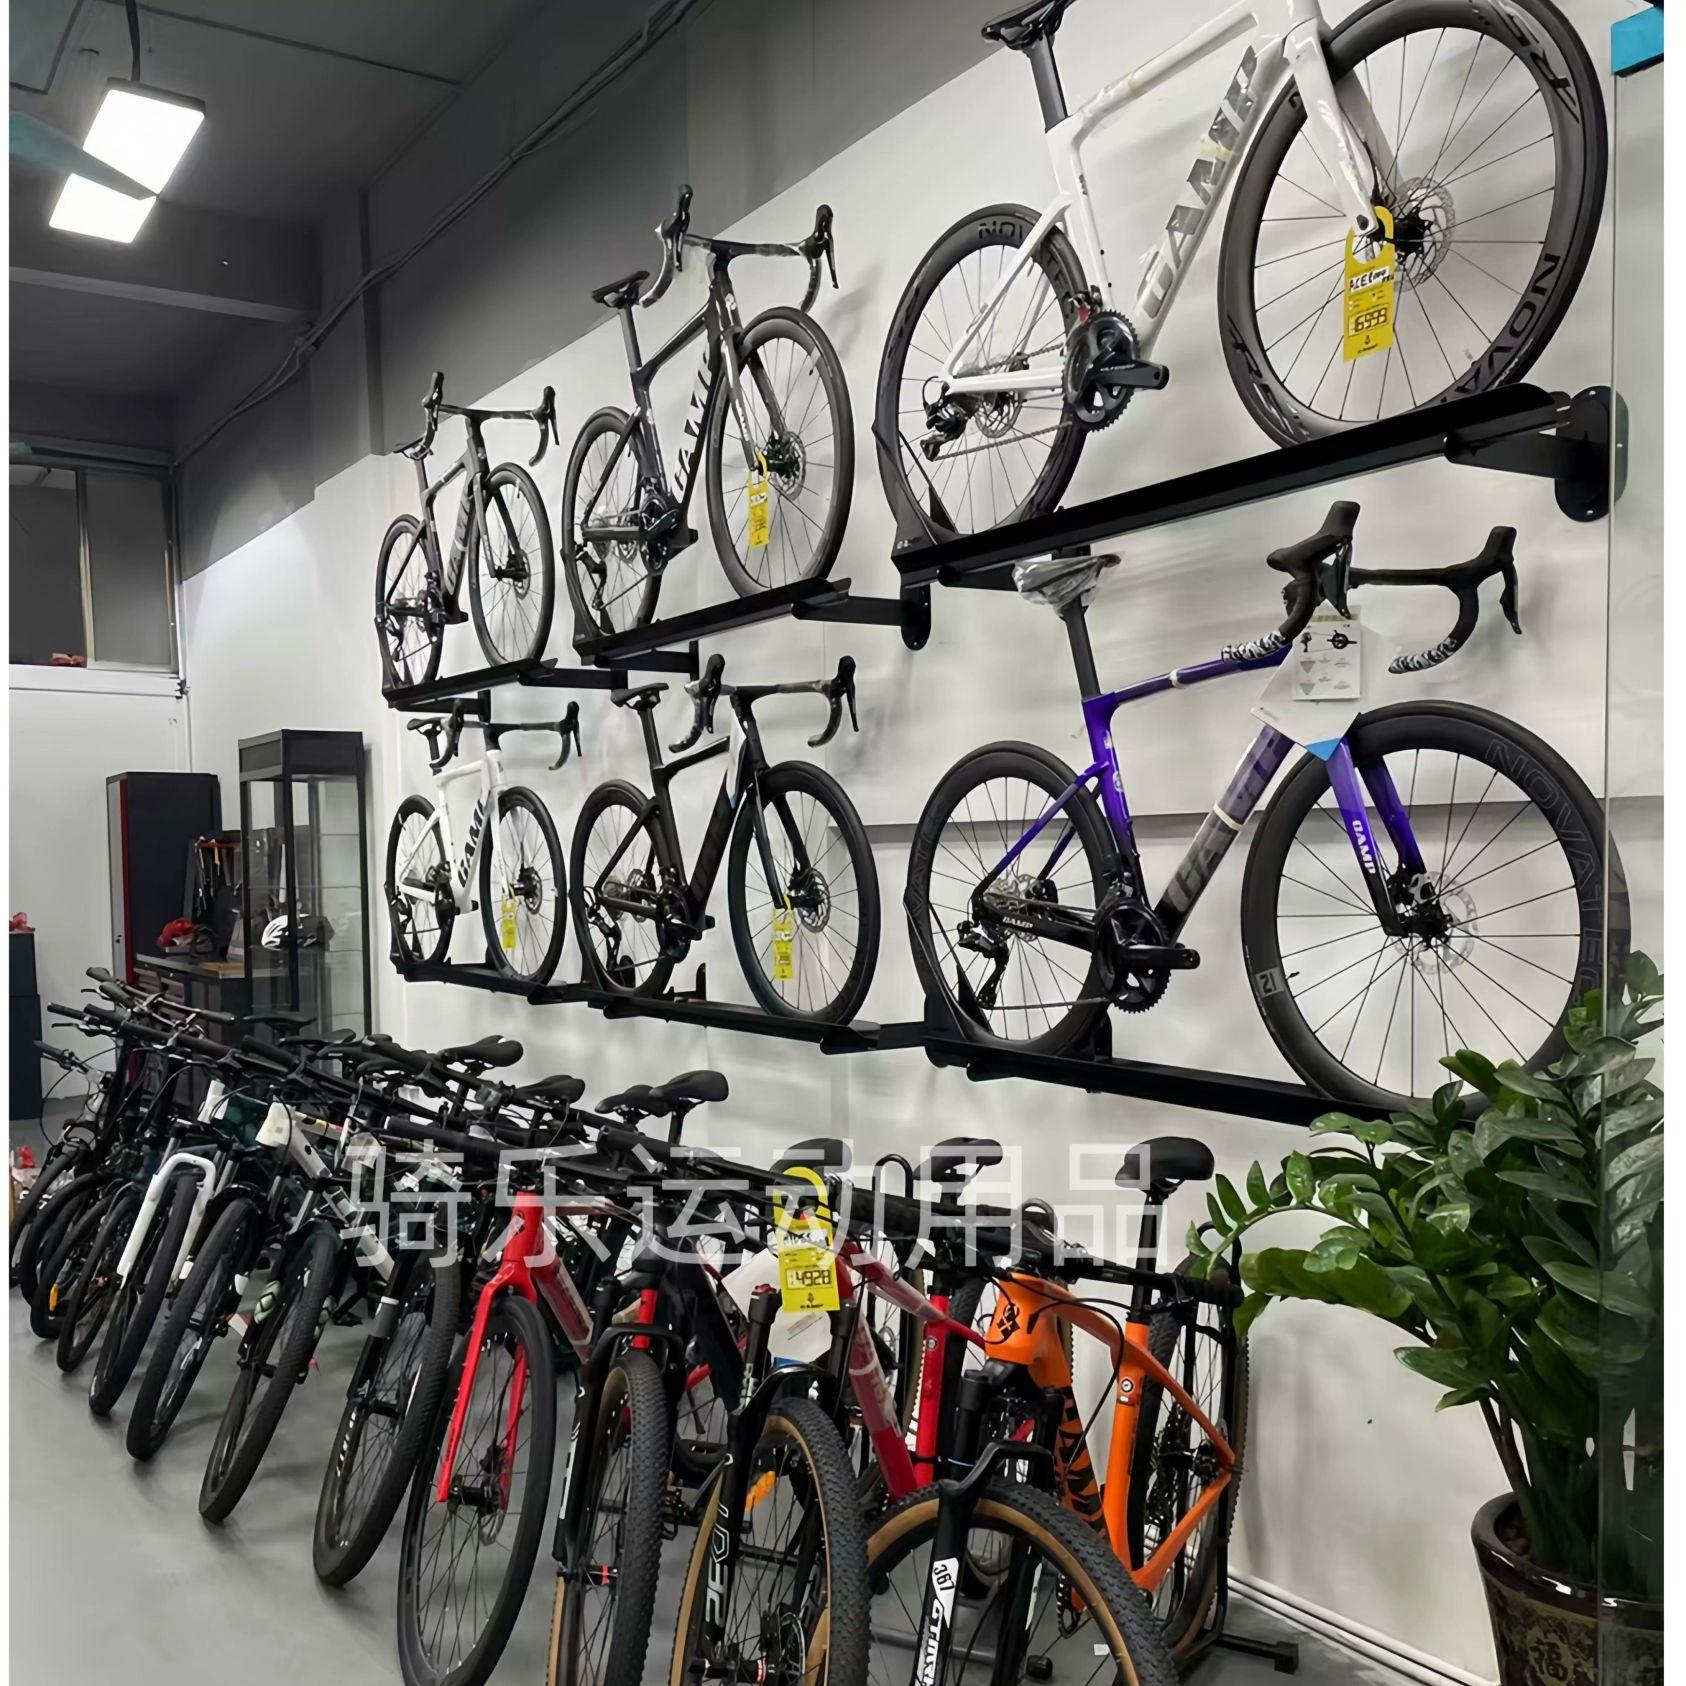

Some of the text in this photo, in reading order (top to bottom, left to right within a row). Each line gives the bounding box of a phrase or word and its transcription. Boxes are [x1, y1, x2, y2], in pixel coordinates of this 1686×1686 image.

[1440, 253, 1560, 403] NOVA
[795, 1269, 832, 1287] 4928
[933, 1564, 955, 1591] 367
